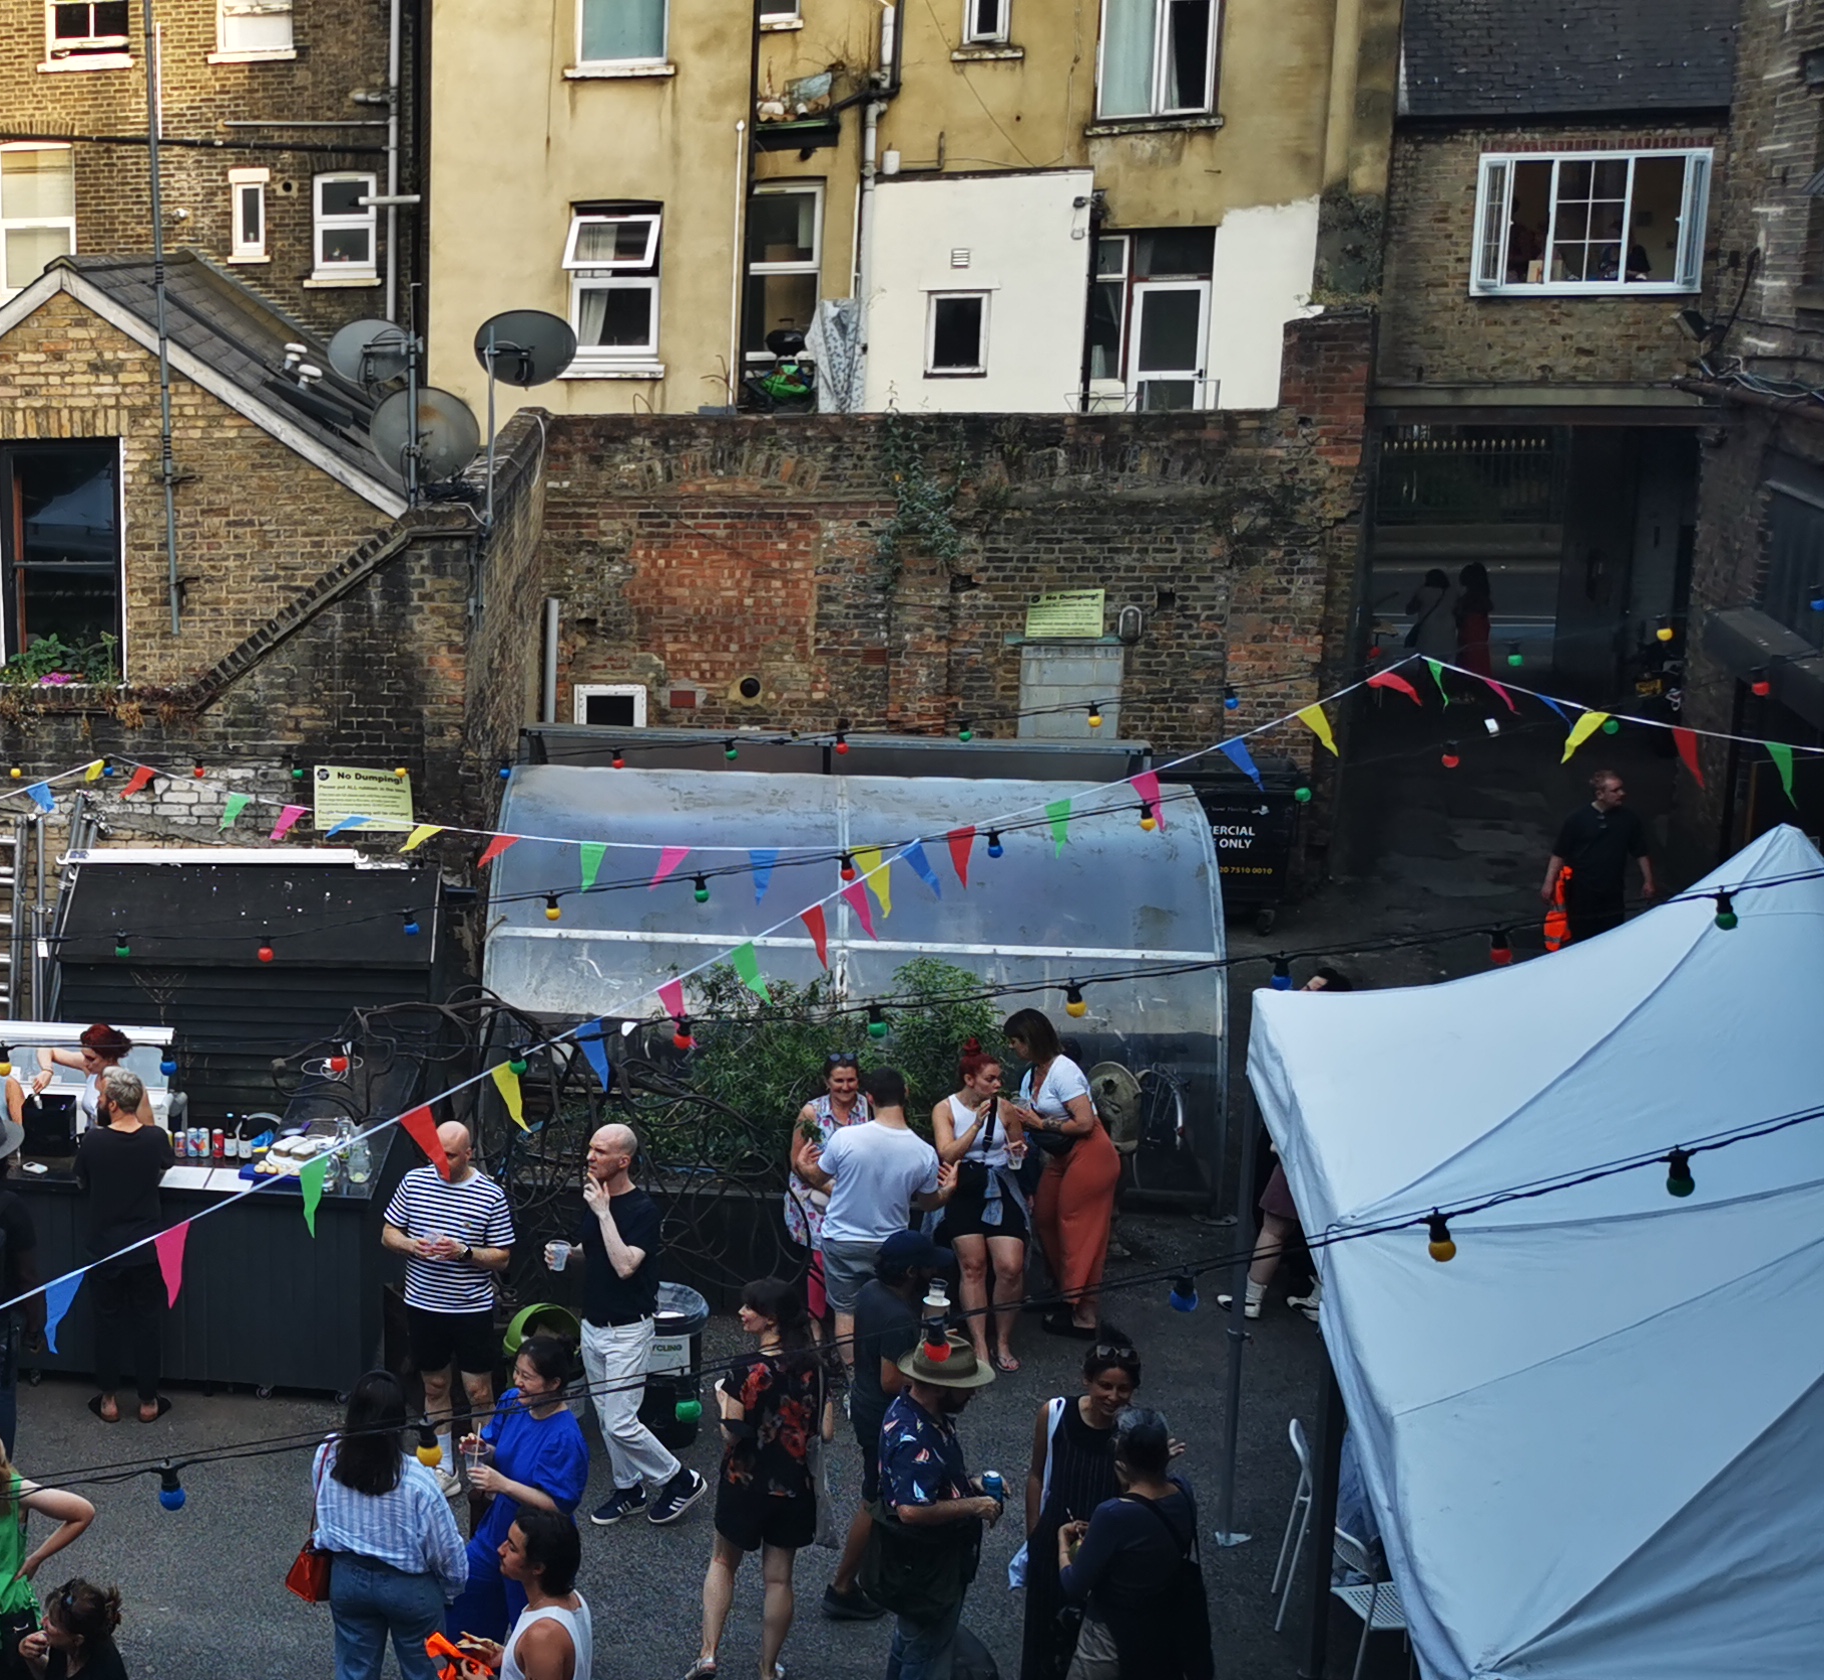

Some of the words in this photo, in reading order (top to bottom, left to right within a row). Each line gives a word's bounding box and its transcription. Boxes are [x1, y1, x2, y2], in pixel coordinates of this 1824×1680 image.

[338, 772, 352, 780] No
[355, 773, 403, 785] Dumping!
[1212, 825, 1256, 836] ERCIAL
[1219, 838, 1252, 849] ONLY
